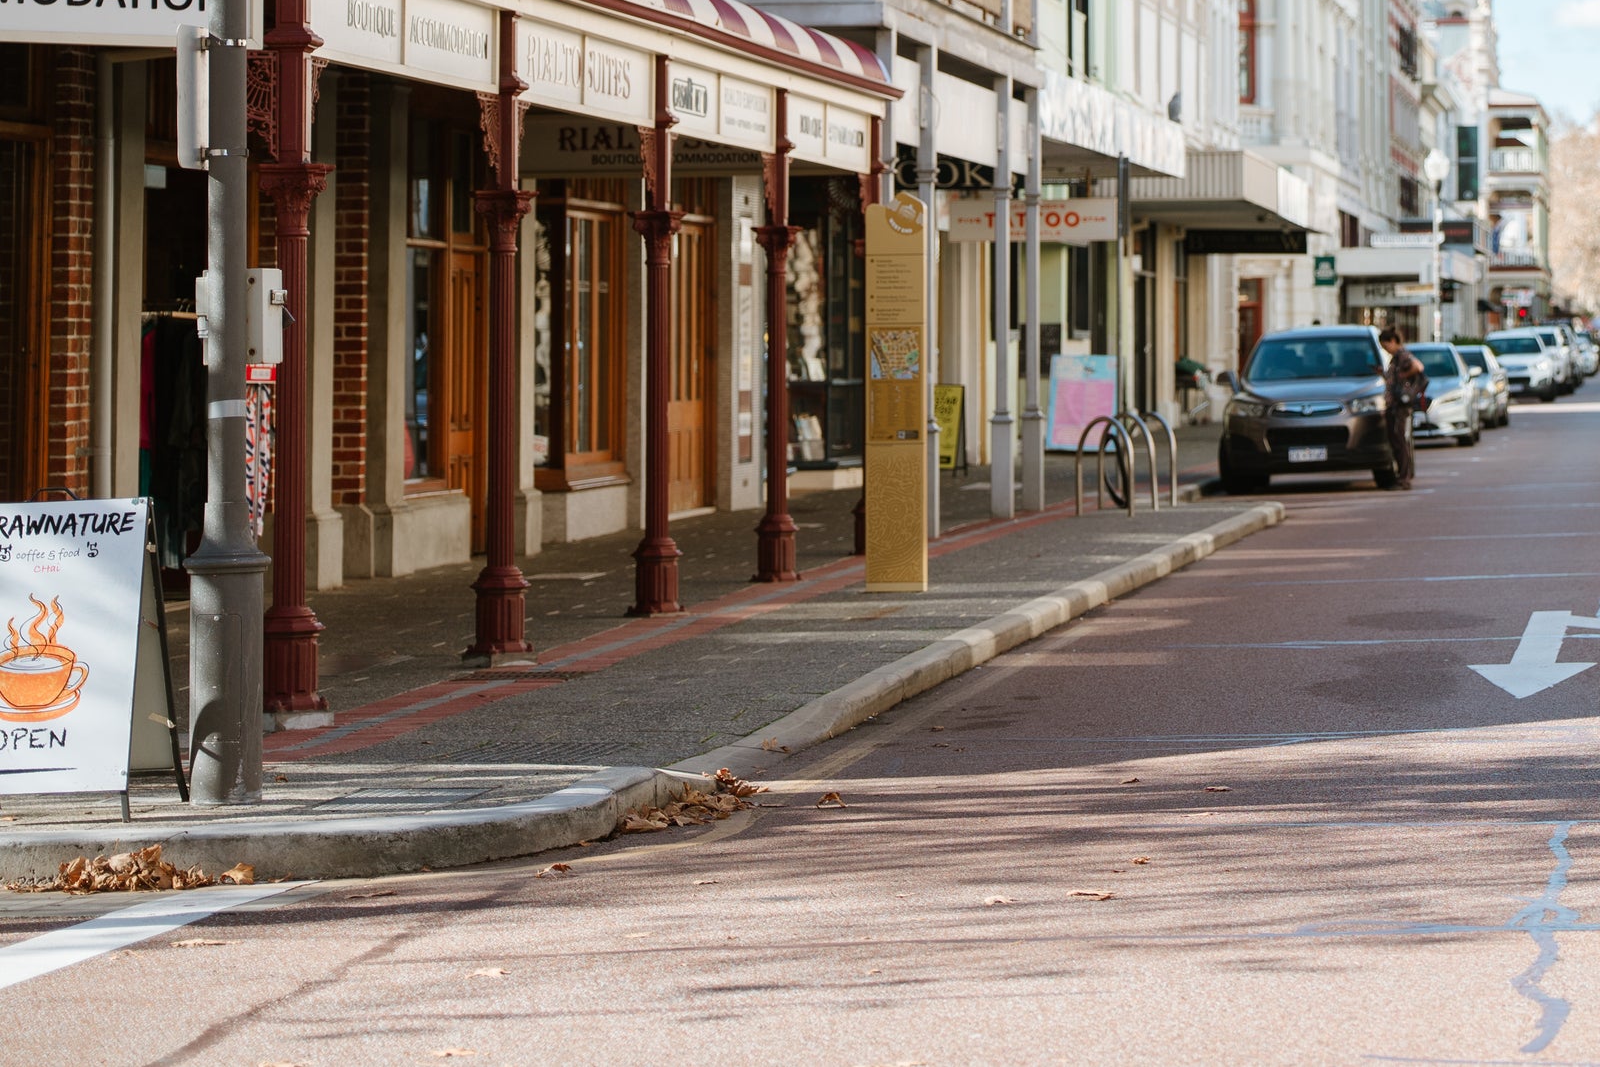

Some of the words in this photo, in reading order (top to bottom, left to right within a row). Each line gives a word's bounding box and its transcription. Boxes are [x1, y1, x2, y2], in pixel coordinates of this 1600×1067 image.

[409, 15, 488, 60] ACCOMMODATION
[526, 34, 581, 89] RIALTO
[587, 50, 631, 99] SUITES
[558, 124, 640, 152] RIAL
[591, 152, 641, 165] BOUTIQU
[985, 211, 1080, 228] TTOO
[0, 512, 136, 539] RAWNATURE
[16, 549, 45, 562] coffee
[59, 547, 80, 561] food
